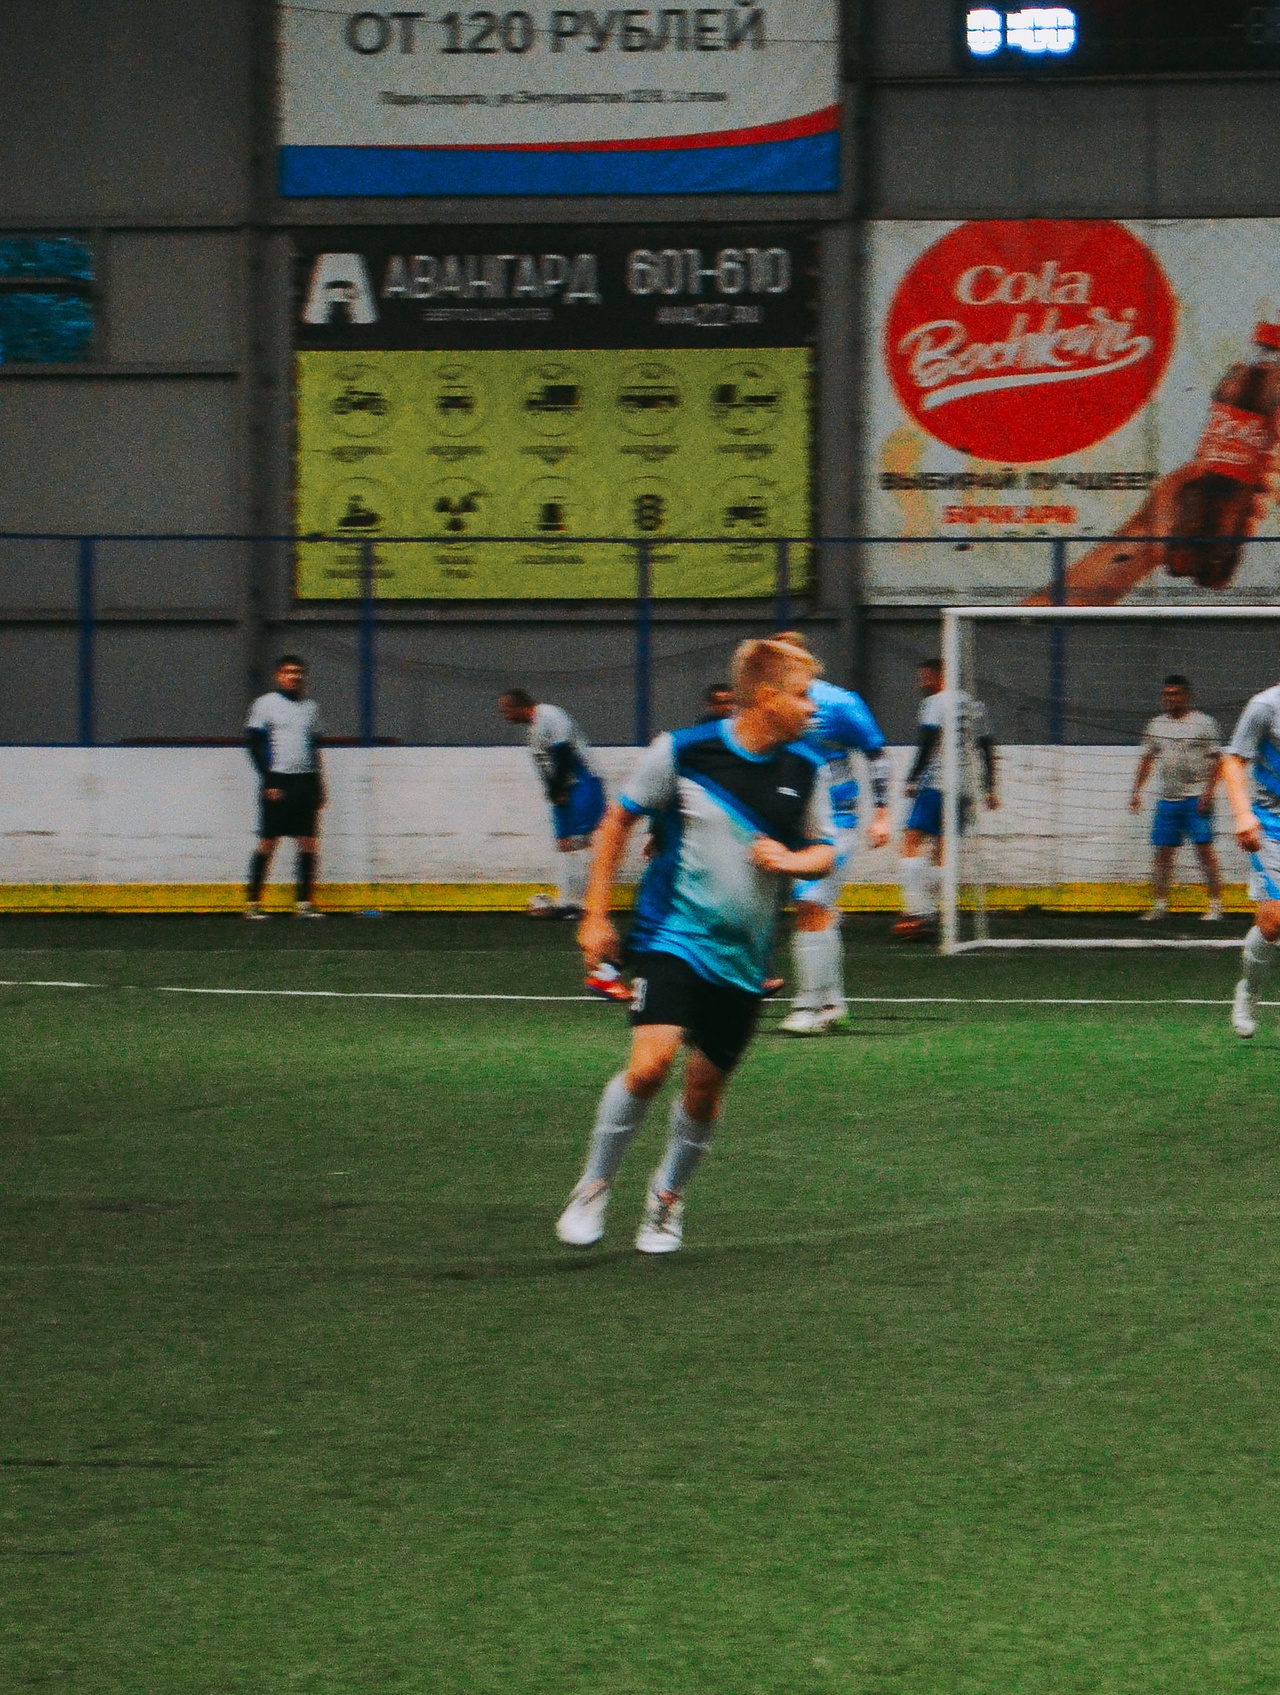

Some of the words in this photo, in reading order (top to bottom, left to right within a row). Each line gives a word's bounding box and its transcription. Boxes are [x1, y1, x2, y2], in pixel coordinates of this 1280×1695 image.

[345, 11, 424, 55] ОТ
[440, 11, 535, 54] 120
[550, 0, 767, 53] РУБЛЕЙ
[381, 253, 602, 304] АВАНГАРД
[625, 248, 792, 296] 601-610
[954, 260, 1095, 306] Cola
